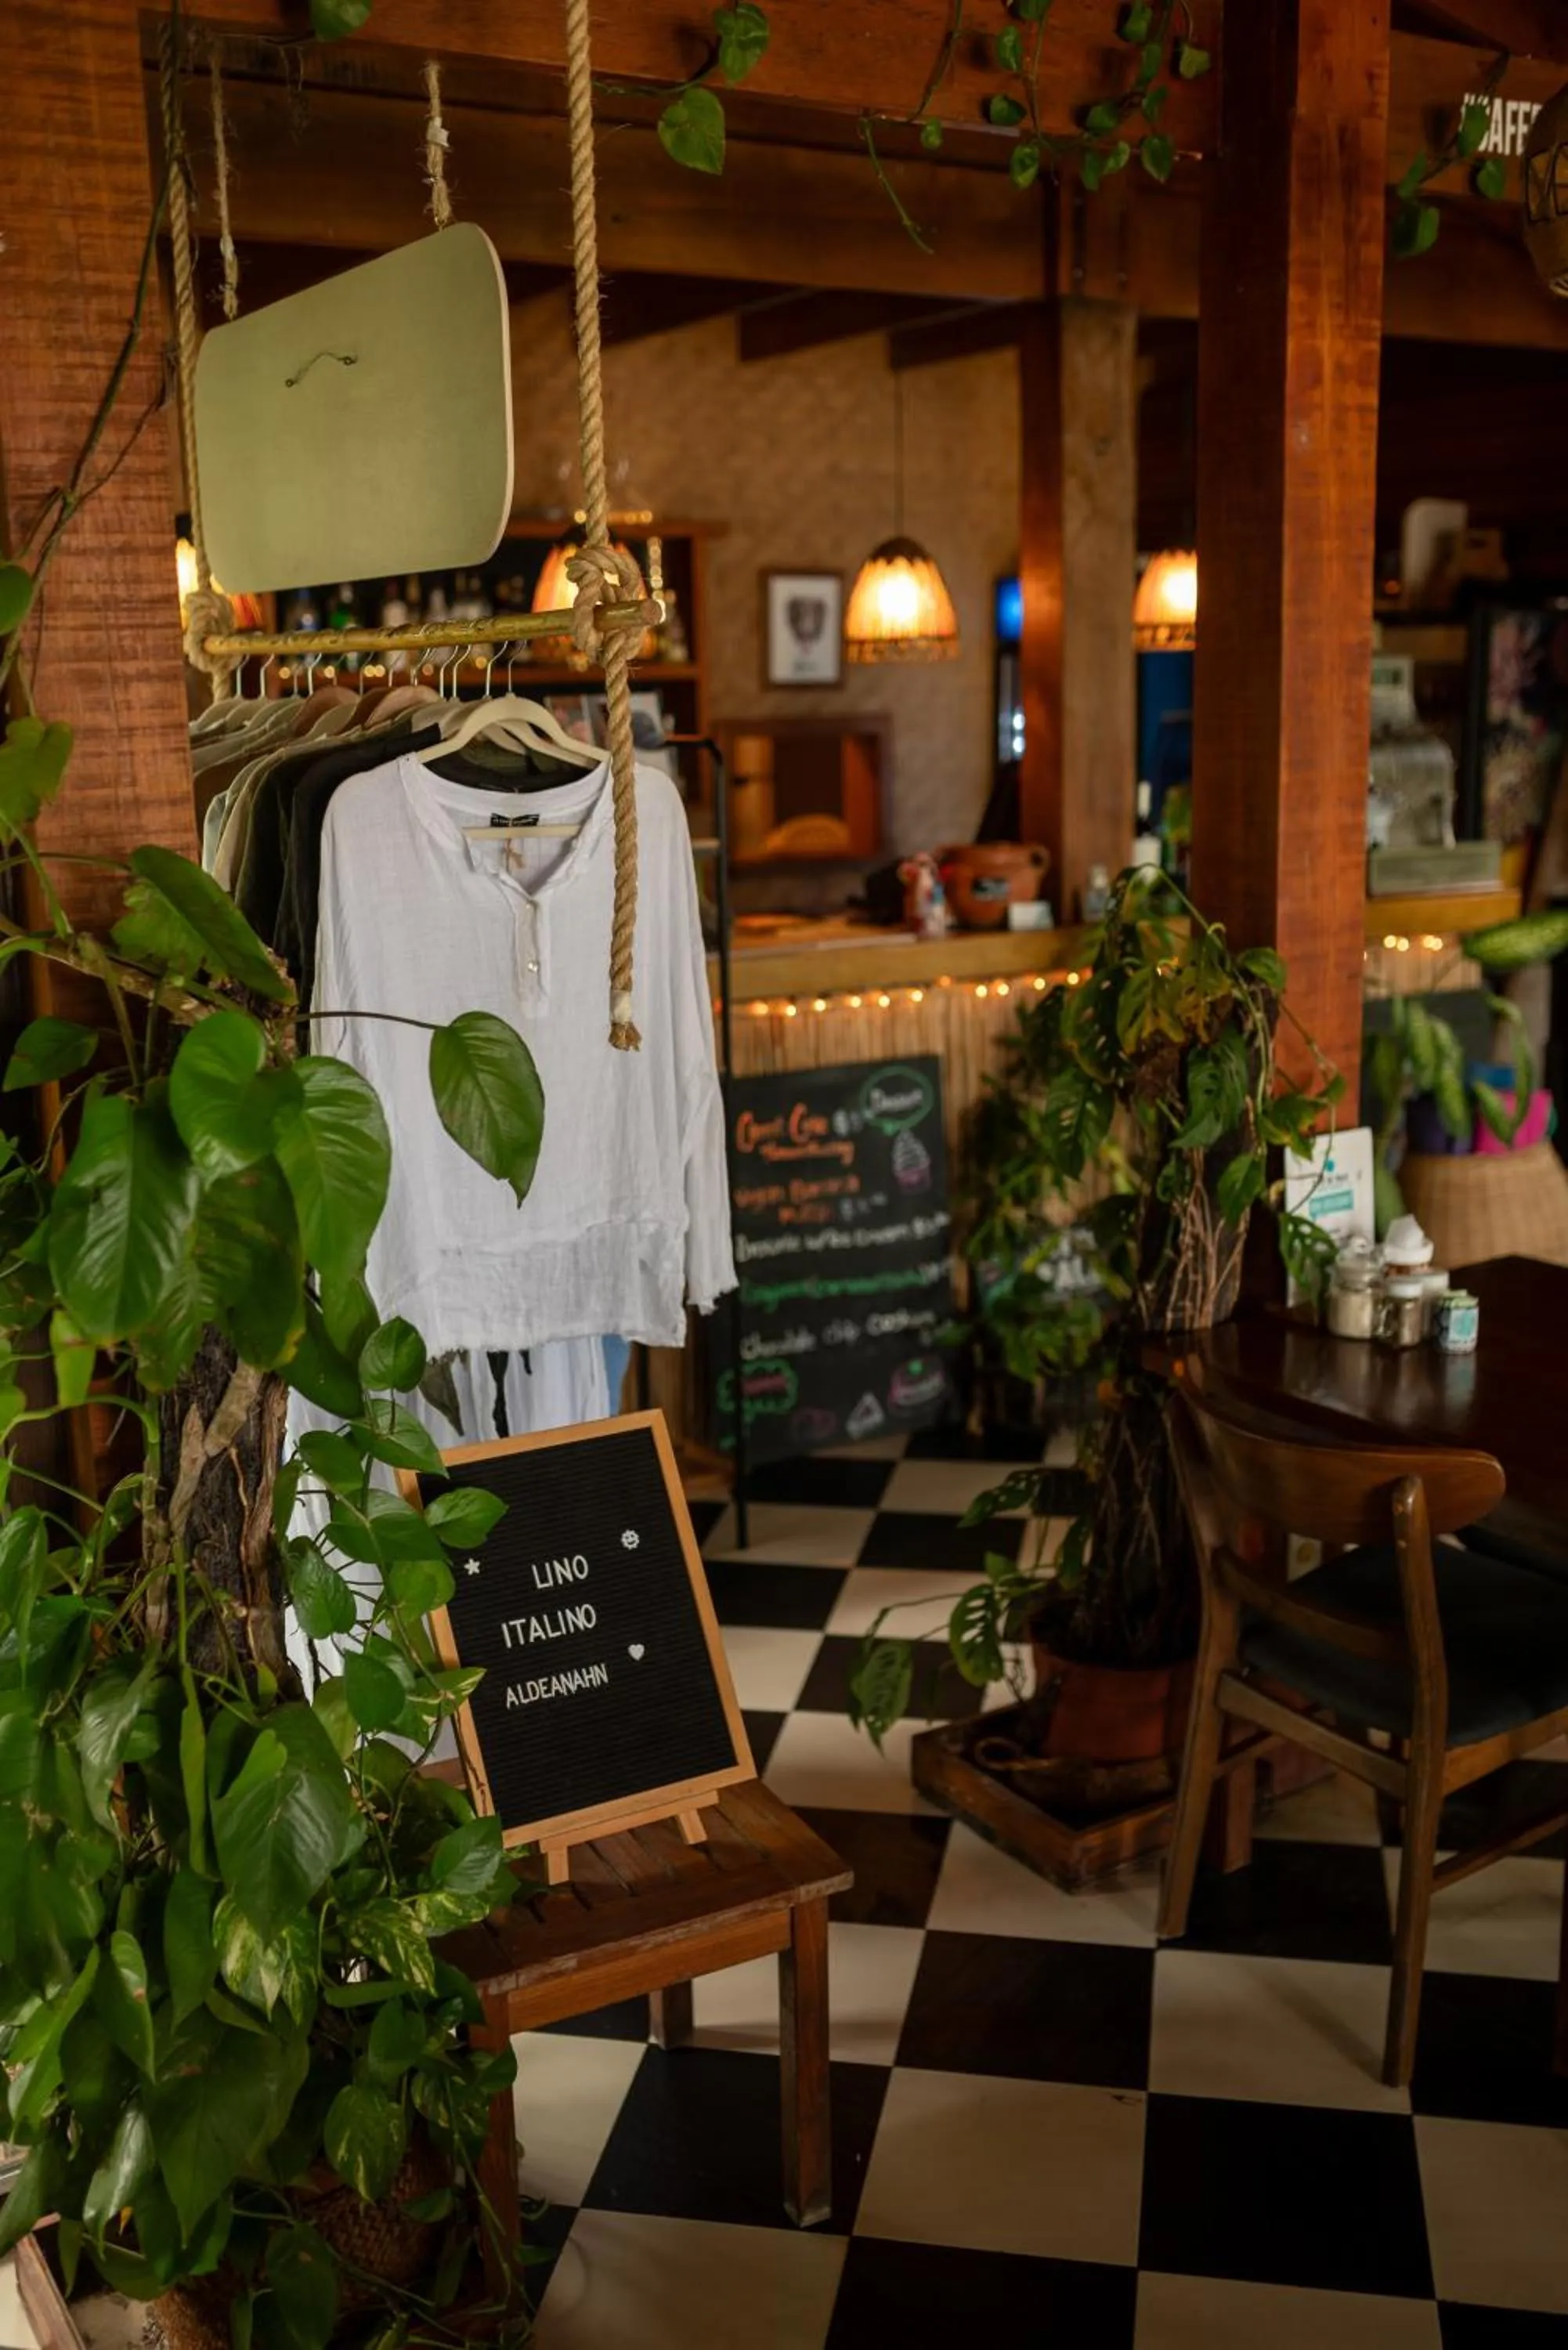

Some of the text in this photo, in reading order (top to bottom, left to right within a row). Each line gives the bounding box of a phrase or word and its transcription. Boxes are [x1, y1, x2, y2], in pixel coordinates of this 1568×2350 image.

[532, 1554, 589, 1589] LINO
[501, 1603, 596, 1649] ITALINO
[506, 1663, 609, 1710] ALDEANAHN
